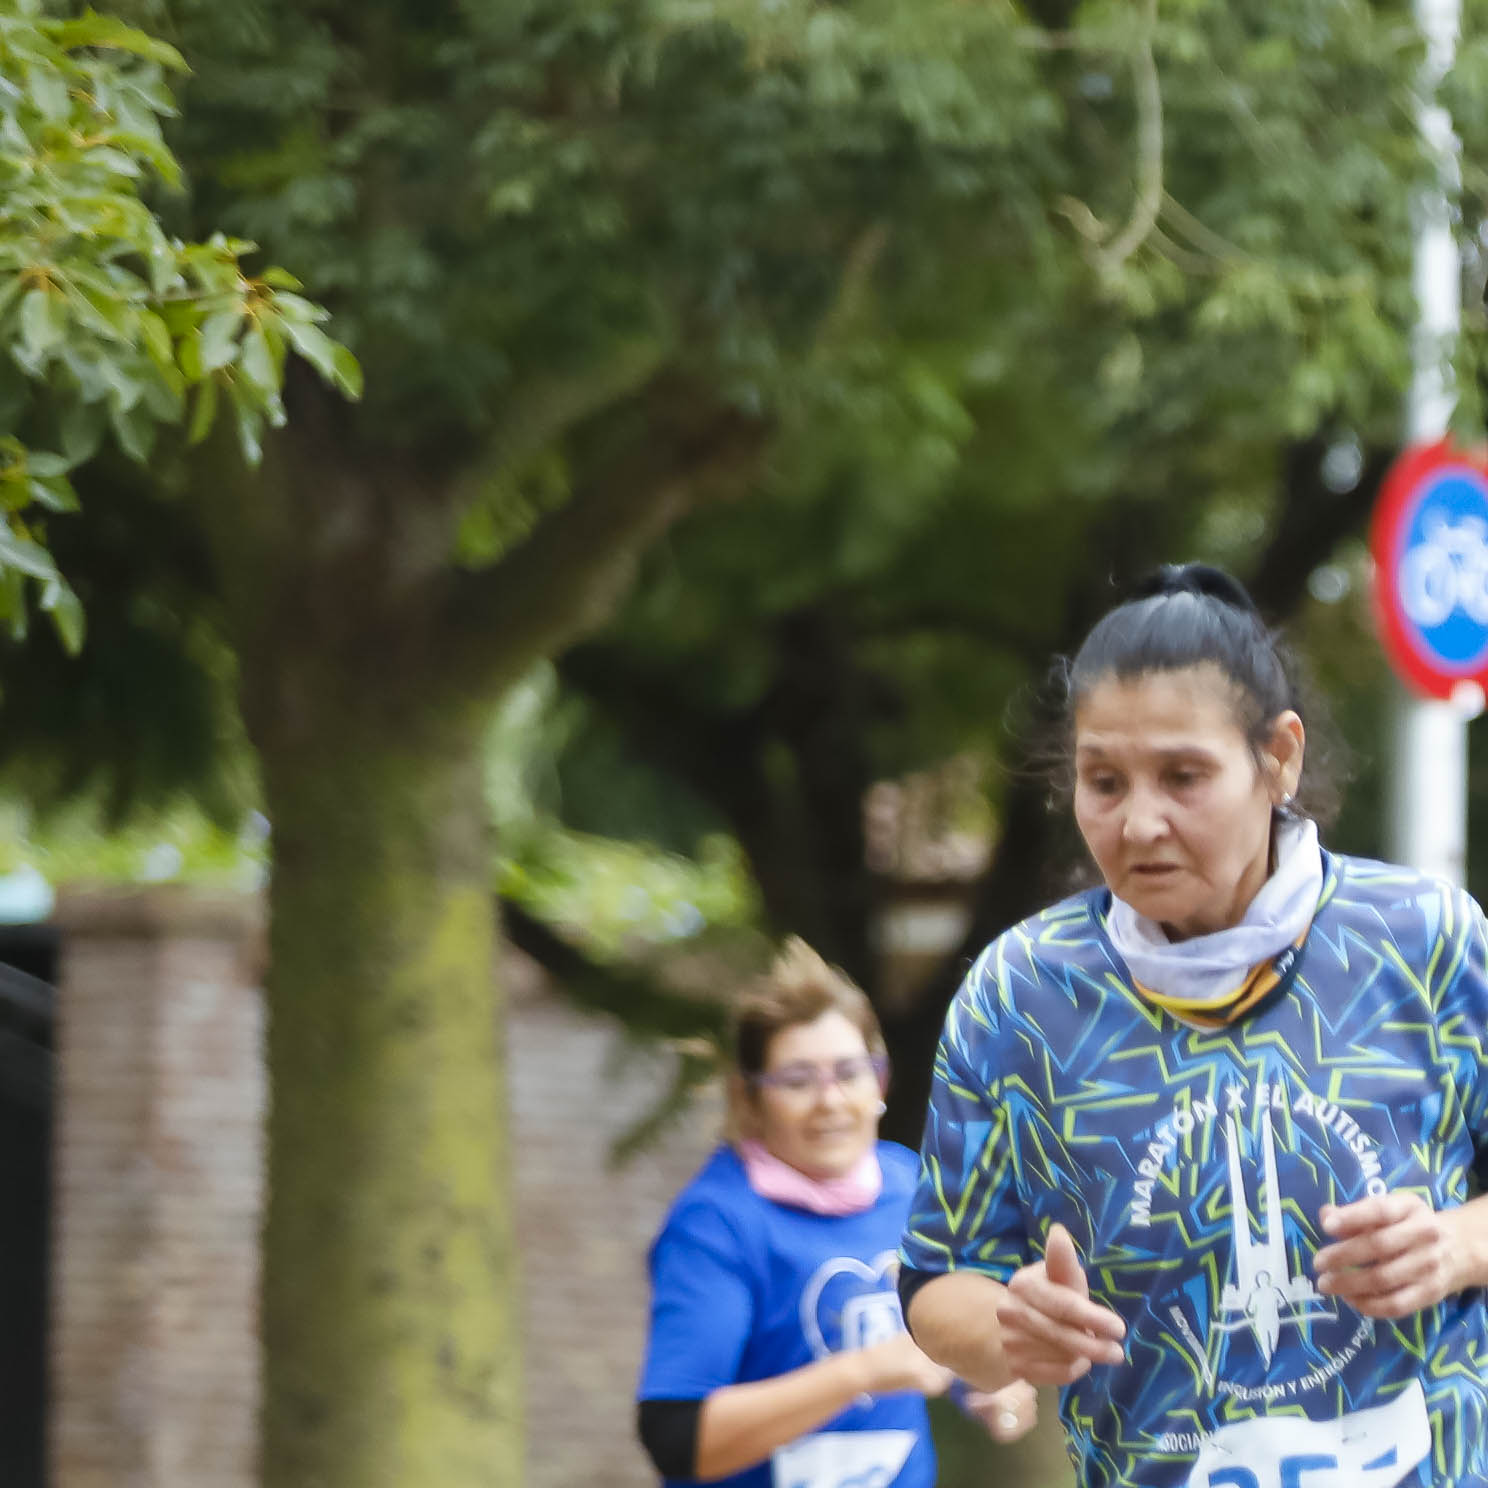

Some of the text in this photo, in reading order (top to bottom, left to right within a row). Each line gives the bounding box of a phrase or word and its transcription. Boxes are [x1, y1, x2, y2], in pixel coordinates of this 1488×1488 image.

[1225, 1084, 1247, 1110] X
[1255, 1083, 1289, 1109] EL
[1293, 1090, 1389, 1199] AUTISMO
